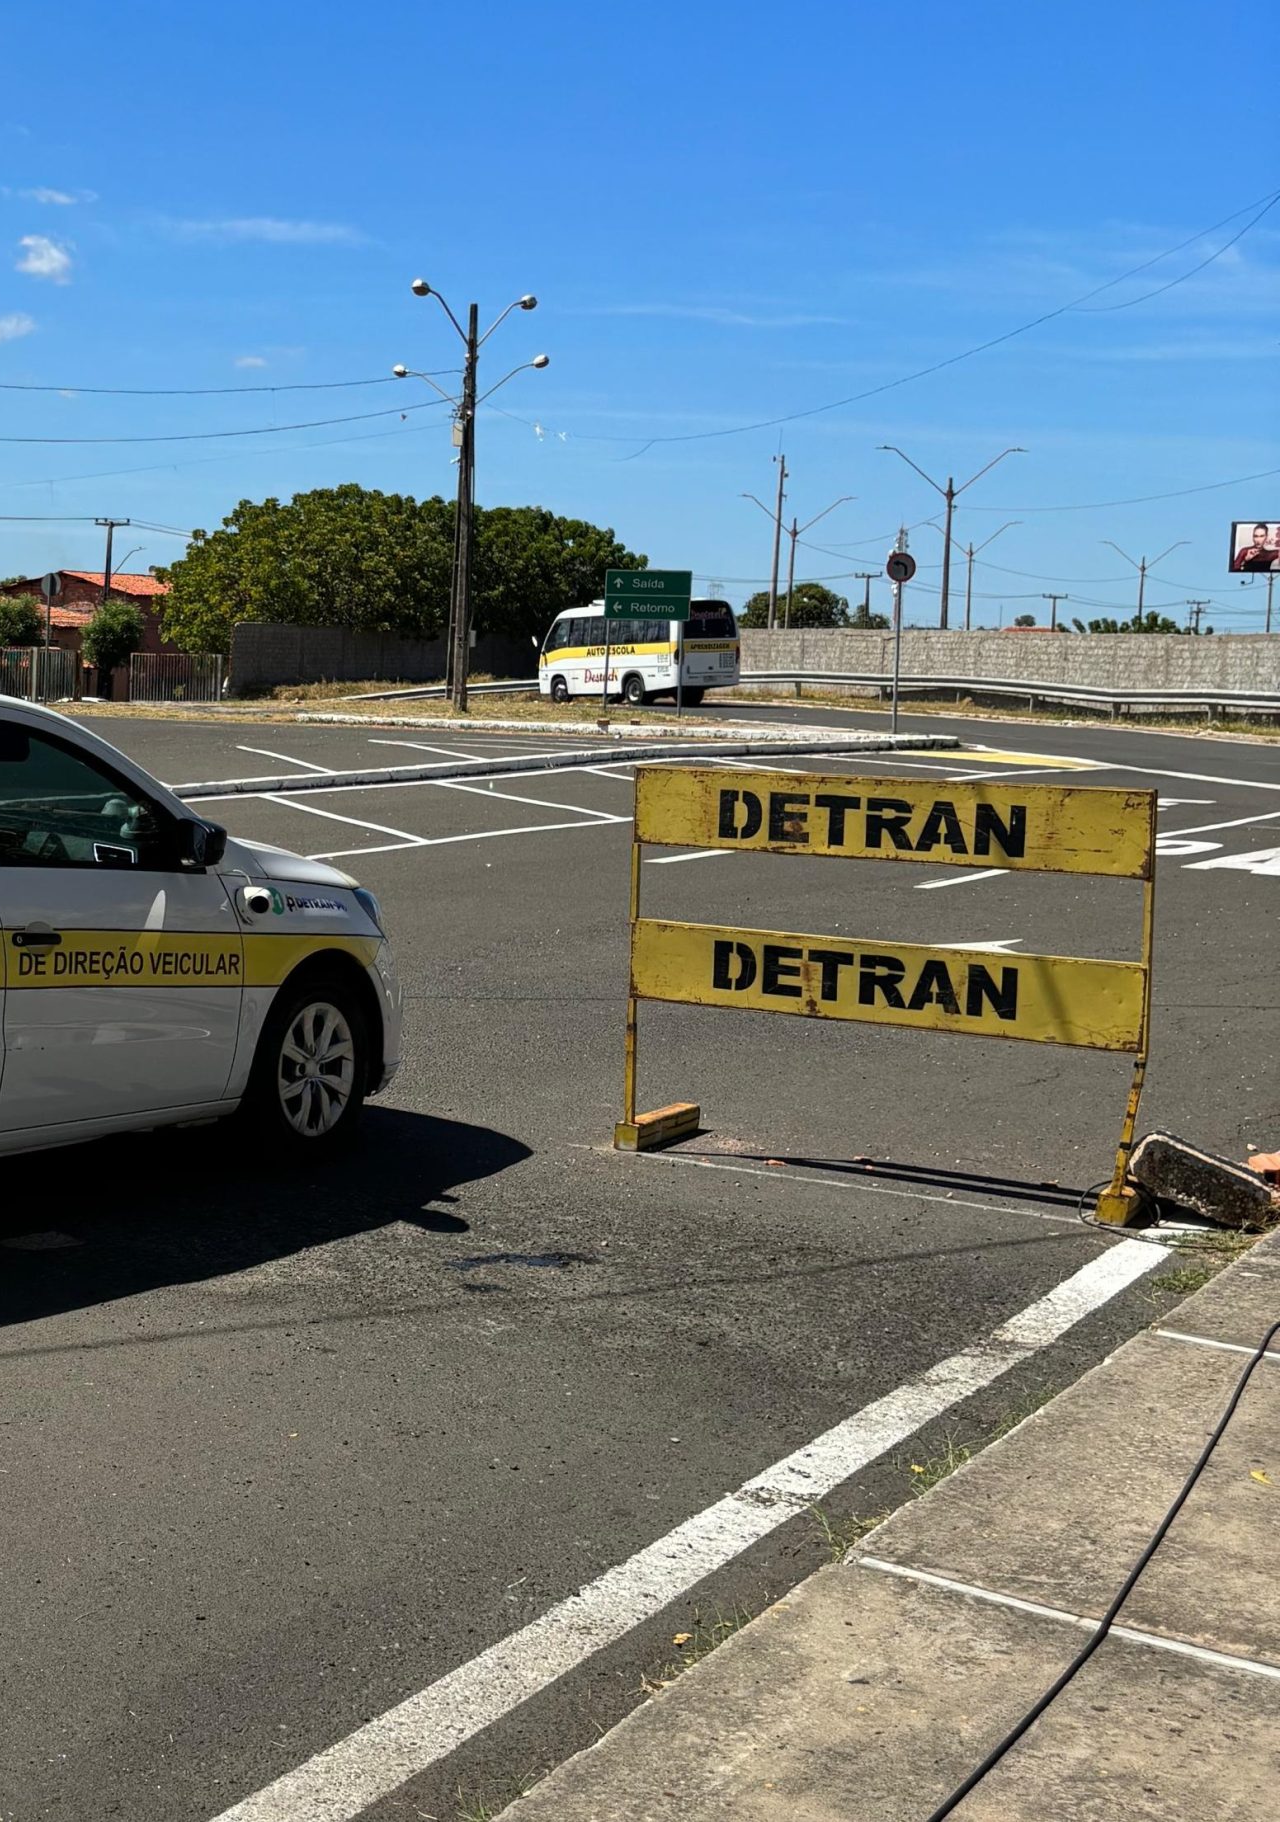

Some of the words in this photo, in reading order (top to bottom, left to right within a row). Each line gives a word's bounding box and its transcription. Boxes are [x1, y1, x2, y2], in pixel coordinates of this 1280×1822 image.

[631, 578, 665, 589] Saída
[630, 602, 675, 613] Retorno
[586, 648, 605, 657] AUTO
[608, 646, 636, 656] ESCOLA
[718, 789, 1027, 858] DETRAN
[19, 952, 46, 976] DE
[53, 946, 144, 980] DIREÇÃO
[149, 952, 240, 976] VEICULAR
[713, 939, 1019, 1021] DETRAN
